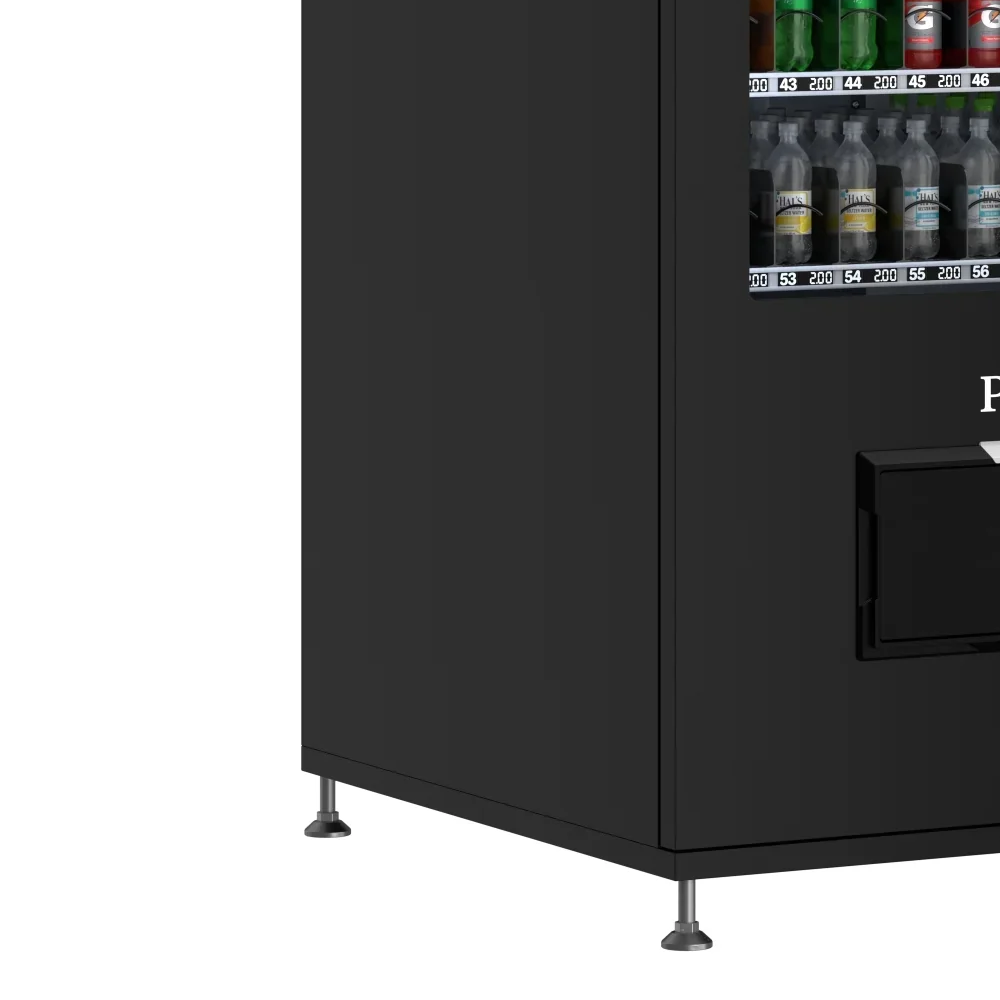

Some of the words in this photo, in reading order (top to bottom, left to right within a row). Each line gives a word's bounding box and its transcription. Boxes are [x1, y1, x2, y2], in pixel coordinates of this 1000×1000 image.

[779, 77, 797, 91] 43
[809, 76, 832, 90] 2.00
[843, 76, 862, 89] 44
[873, 75, 896, 89] 2.00
[908, 74, 926, 87] 45
[937, 74, 960, 87] 2.00
[971, 73, 989, 86] 46
[779, 272, 796, 285] 53
[809, 270, 832, 284] 2.00
[844, 269, 861, 283] 54
[873, 268, 896, 282] 2.00
[909, 267, 925, 280] 55
[937, 266, 960, 279] 2.00
[972, 264, 989, 278] 56
